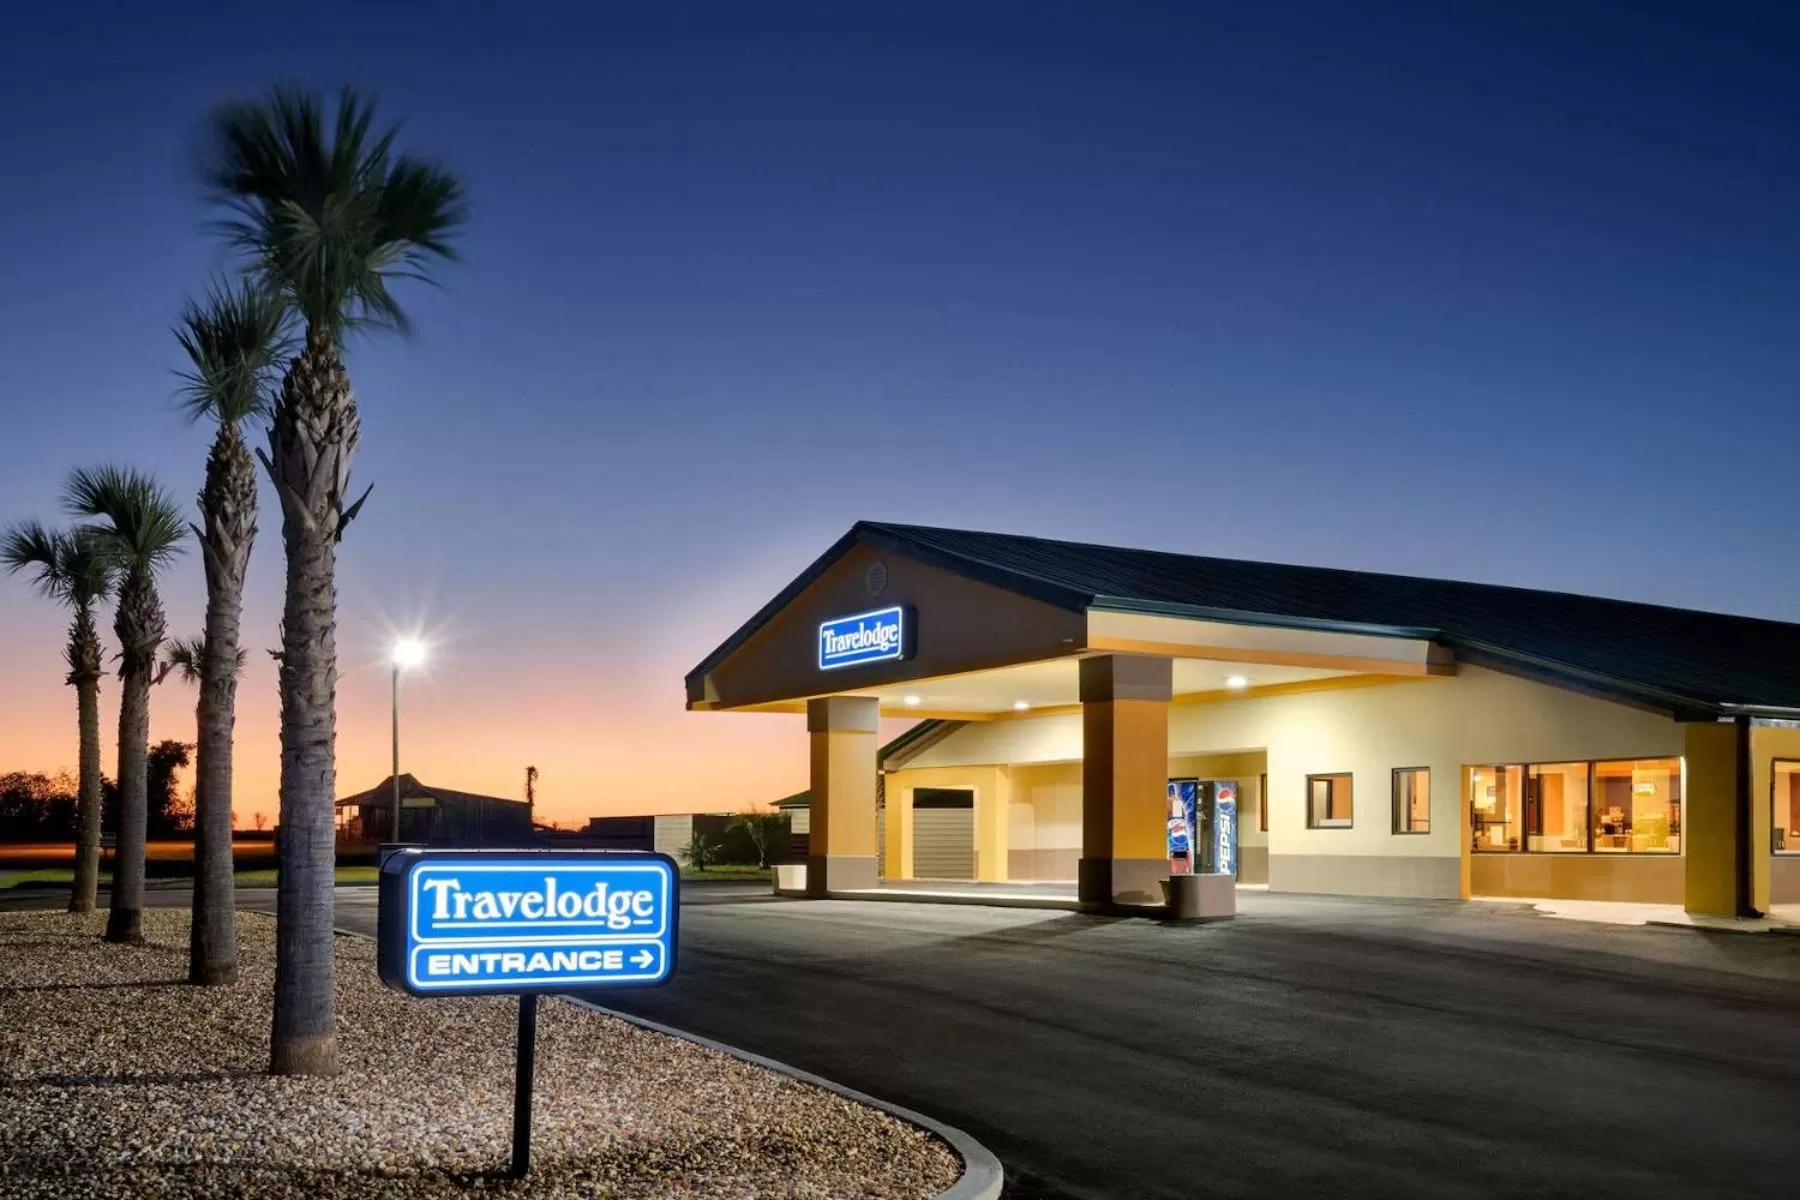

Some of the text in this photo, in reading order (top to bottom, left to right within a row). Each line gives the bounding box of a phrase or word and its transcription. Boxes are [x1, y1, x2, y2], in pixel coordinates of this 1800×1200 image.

[823, 621, 898, 653] Travelodge
[423, 877, 654, 930] Travelodge
[428, 950, 624, 975] ENTRANCE
